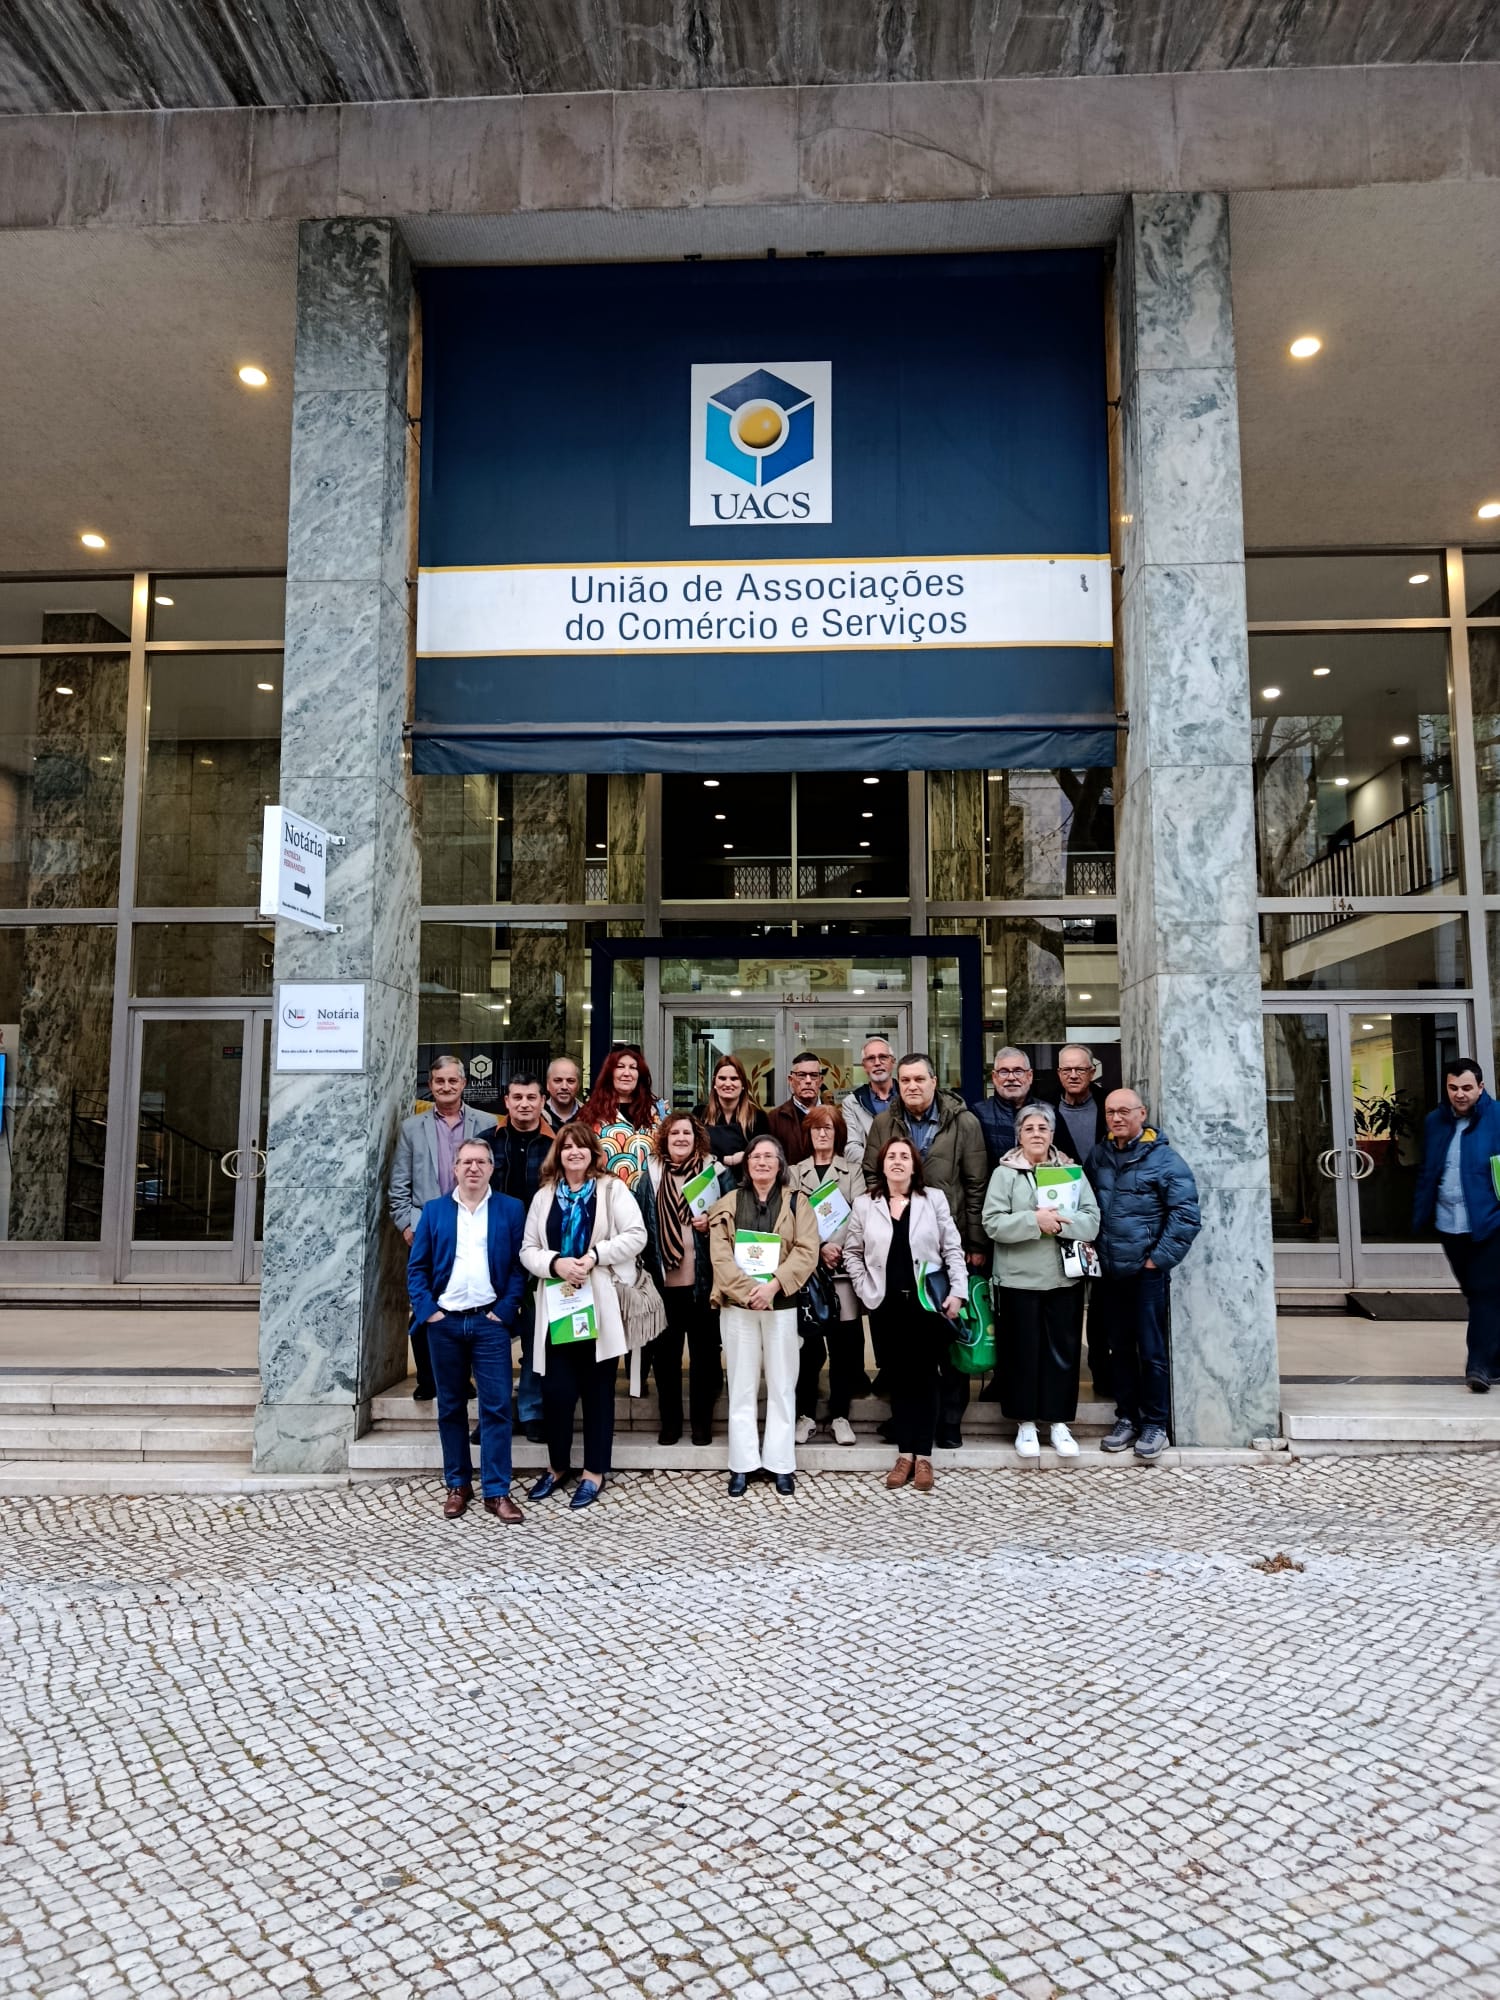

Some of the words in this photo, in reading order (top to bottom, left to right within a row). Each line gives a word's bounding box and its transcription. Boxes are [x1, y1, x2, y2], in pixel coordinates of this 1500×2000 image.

[711, 491, 811, 520] UACS
[571, 575, 668, 604] União
[682, 574, 722, 602] de
[736, 569, 964, 606] Associações
[565, 613, 605, 641] do
[618, 611, 778, 641] Comércio
[791, 616, 808, 639] e
[822, 607, 967, 643] Serviços
[284, 821, 323, 858] Notária
[317, 1008, 360, 1019] Notária
